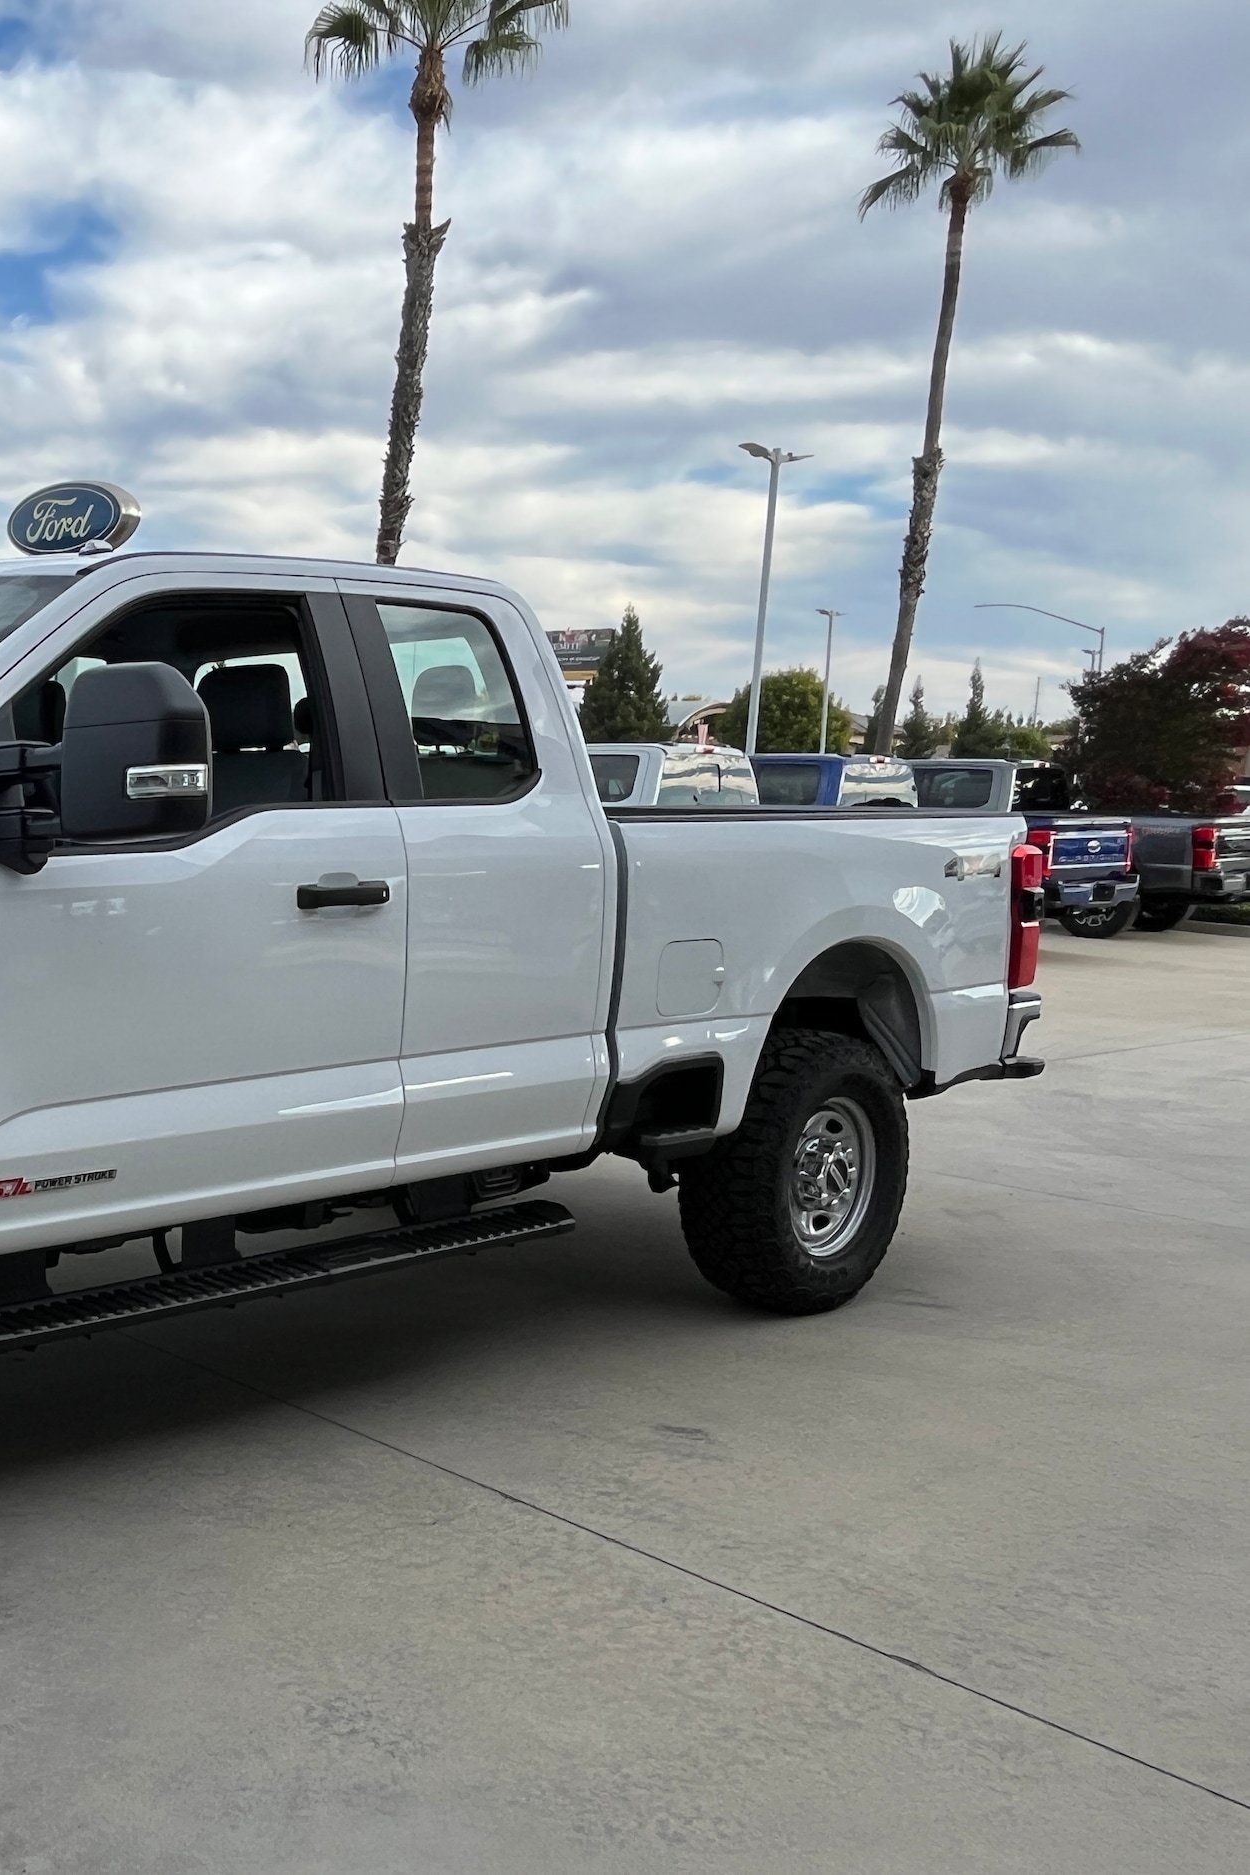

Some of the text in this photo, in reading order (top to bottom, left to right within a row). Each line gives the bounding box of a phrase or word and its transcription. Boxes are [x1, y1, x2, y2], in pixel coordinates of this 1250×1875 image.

[26, 497, 94, 543] Ford
[34, 1175, 72, 1191] POWER
[74, 1169, 117, 1184] STROKE
